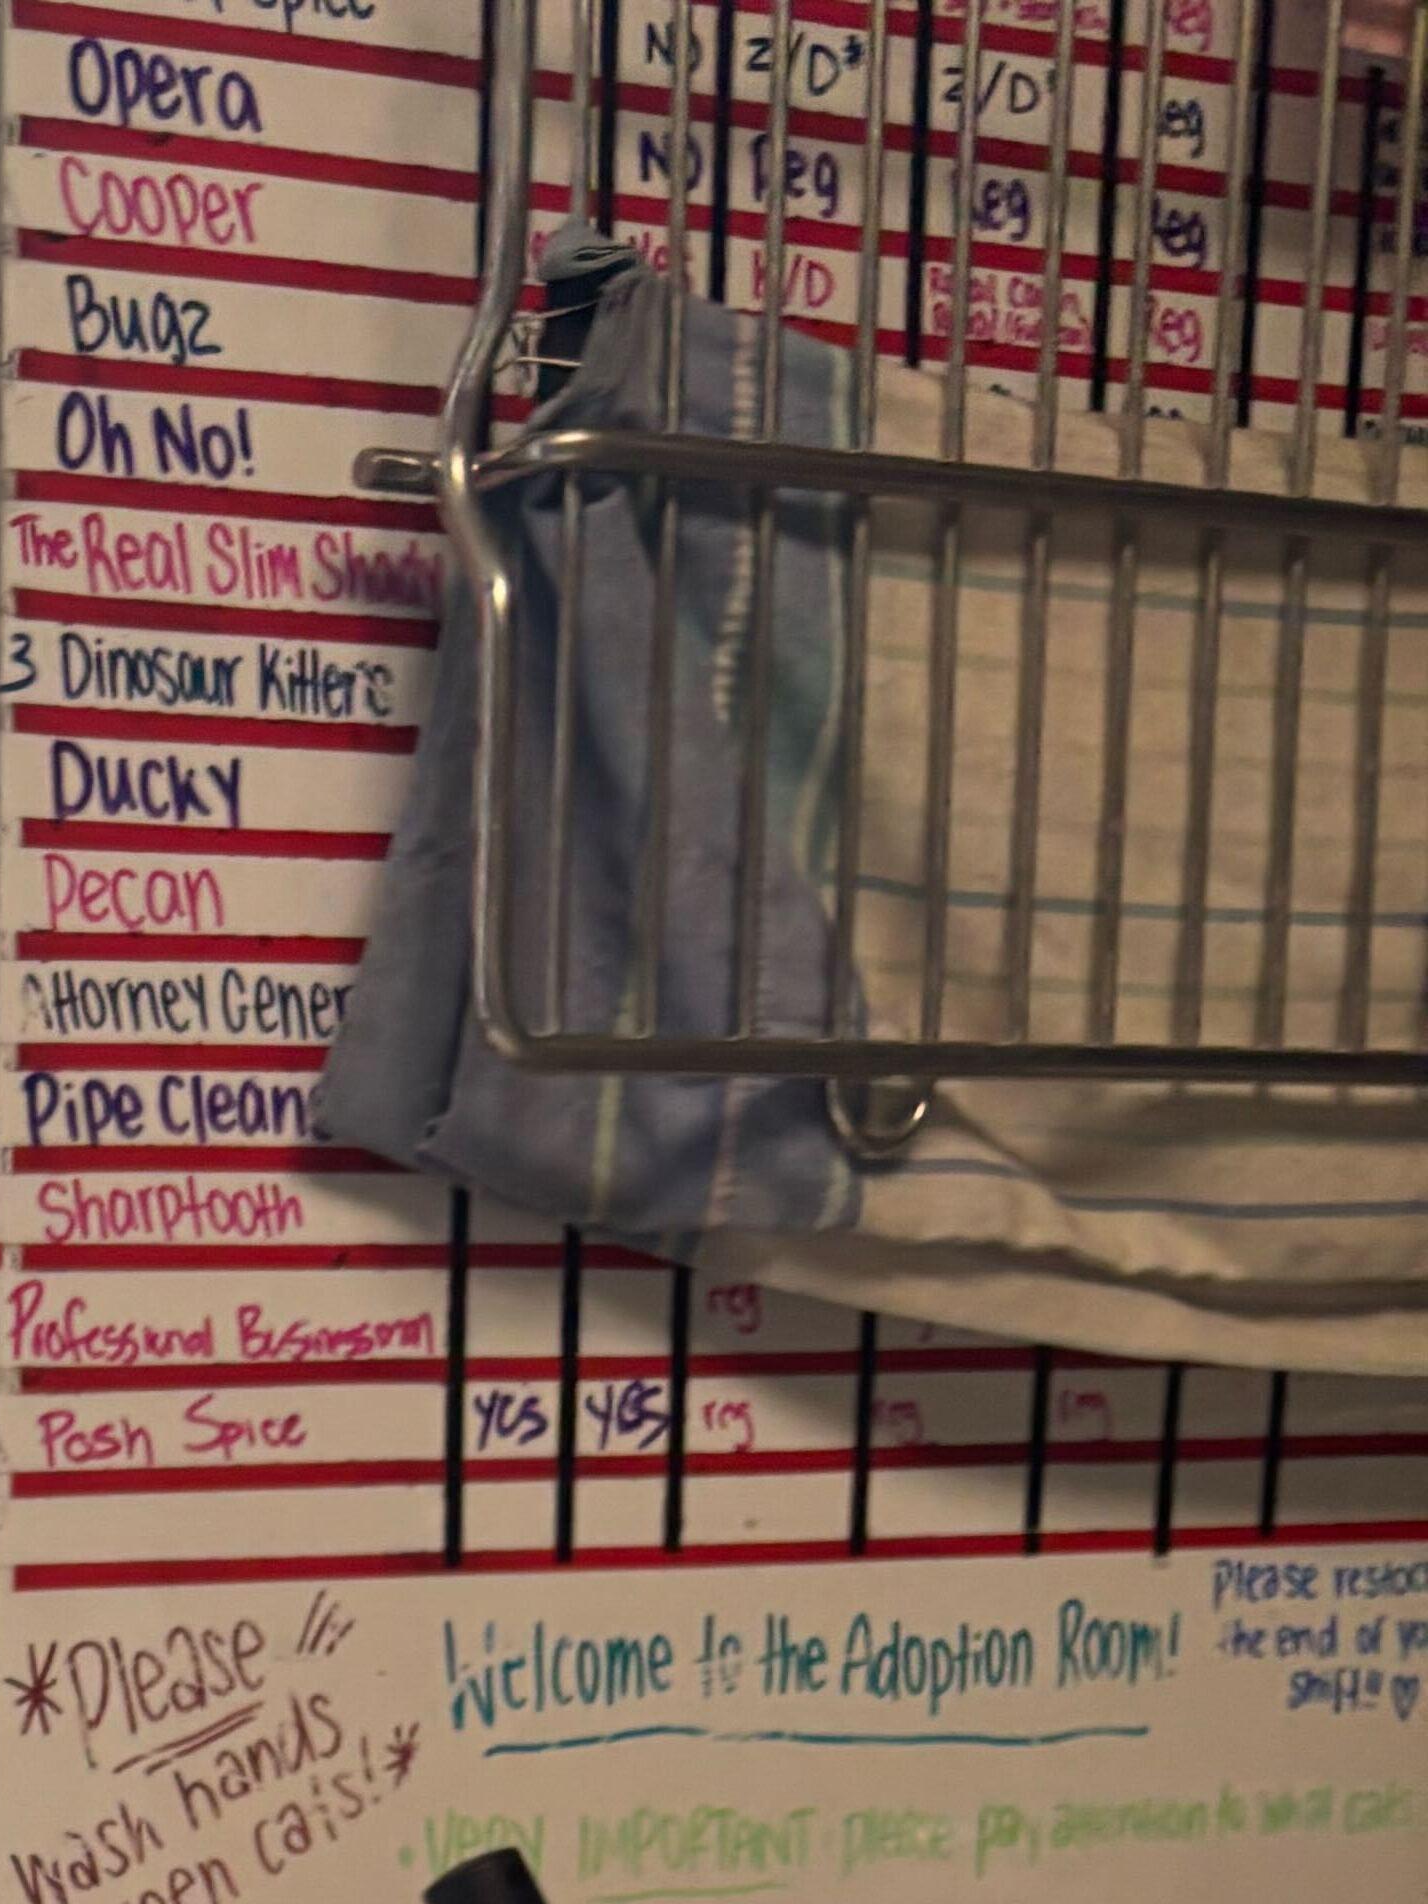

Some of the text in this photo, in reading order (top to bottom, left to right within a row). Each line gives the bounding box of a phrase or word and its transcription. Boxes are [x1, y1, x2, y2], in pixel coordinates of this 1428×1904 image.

[69, 38, 262, 133] Opera
[60, 156, 264, 246] Cooper
[67, 273, 223, 365] Bugz
[58, 391, 255, 480] Oh No!
[10, 513, 79, 569] The
[82, 513, 190, 594] Real
[206, 522, 304, 600] Slim
[60, 633, 243, 706] Dinosaur
[52, 741, 242, 830] Ducky
[44, 854, 224, 930] Pecan
[23, 1072, 143, 1147] Pipe
[38, 1176, 304, 1244] Sharptooth
[37, 1394, 307, 1467] Posh Spice
[444, 1620, 673, 1731] Welcome
[758, 1612, 828, 1696] the
[840, 1610, 1035, 1716] Adoption
[1058, 1597, 1181, 1688] Room!
[173, 1692, 343, 1831] hands
